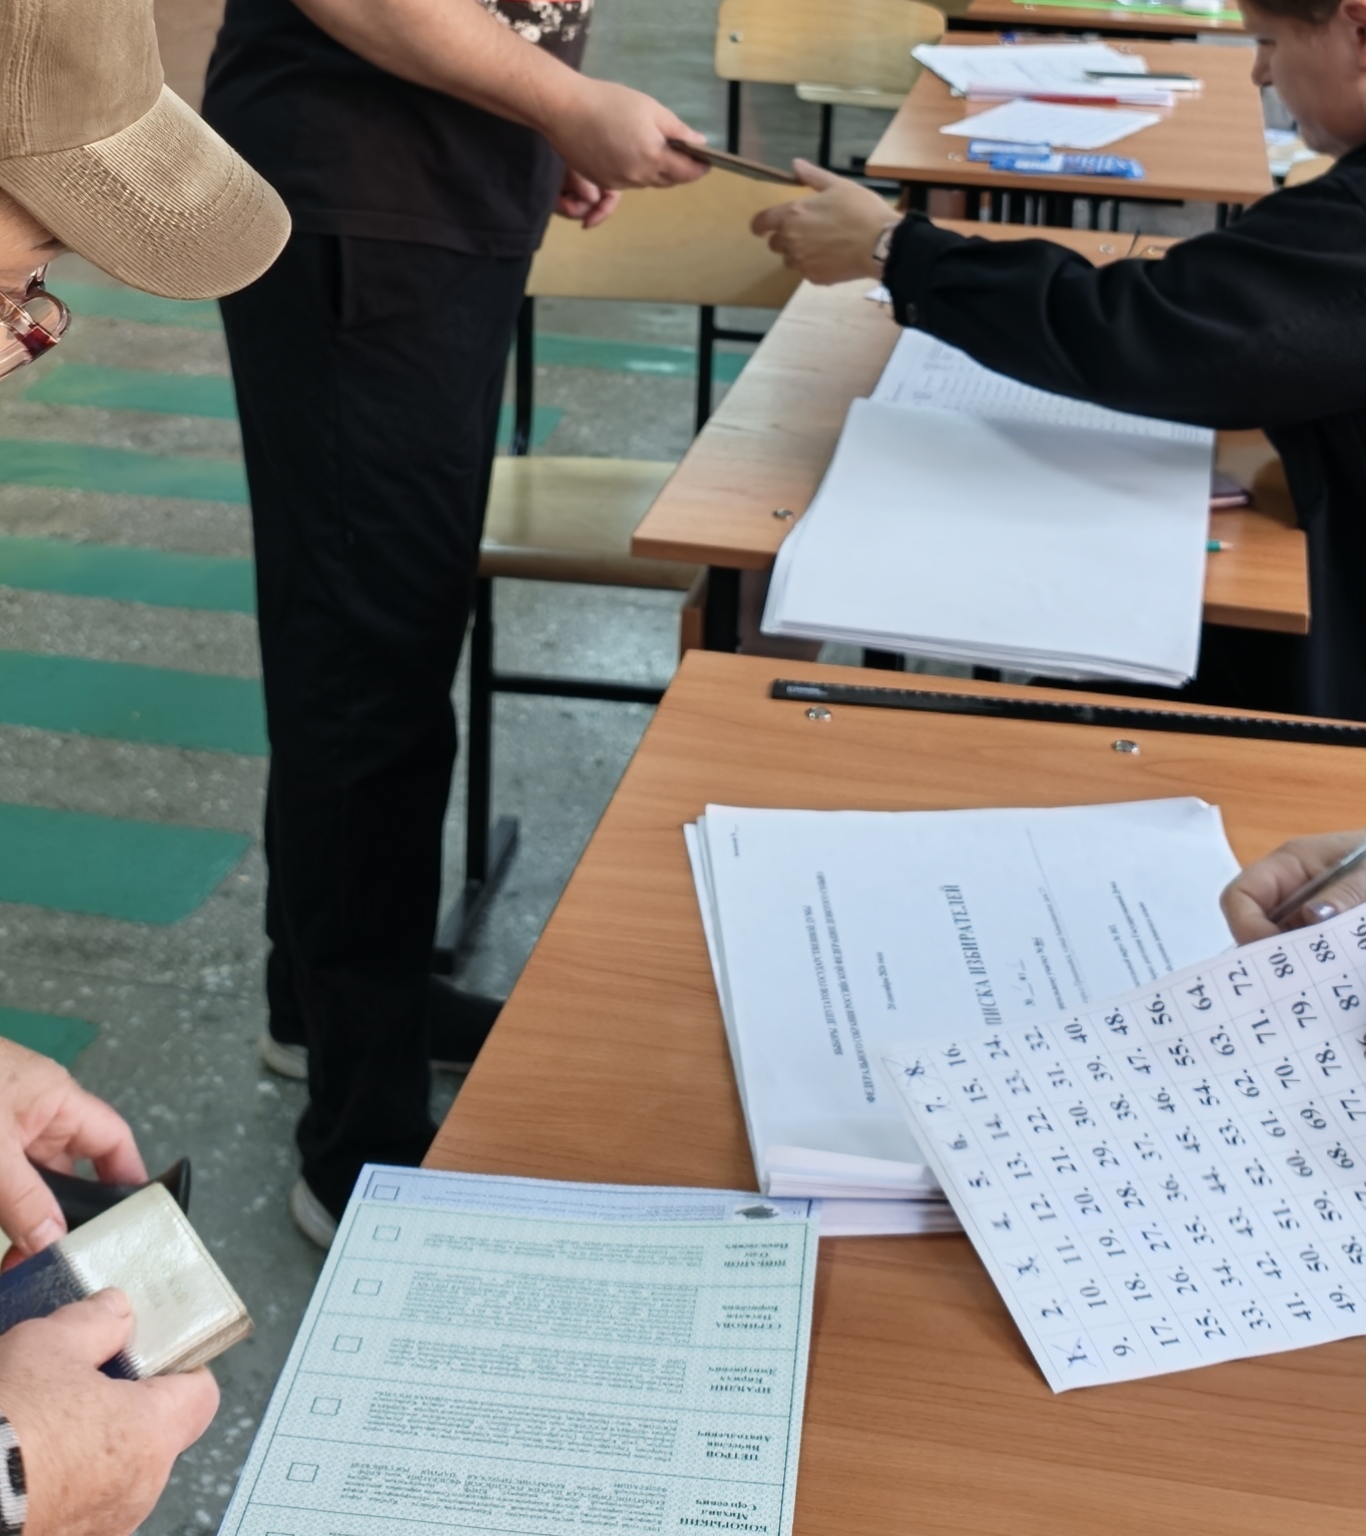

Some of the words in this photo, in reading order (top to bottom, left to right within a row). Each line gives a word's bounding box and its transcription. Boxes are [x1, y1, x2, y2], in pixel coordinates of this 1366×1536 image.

[943, 885, 987, 975] ИЗБИРАТЕЛЕЙ
[1268, 945, 1295, 979] 80.
[1307, 935, 1336, 964] 88.
[1227, 959, 1253, 997] 72.
[1331, 973, 1360, 1012] 87.
[975, 979, 1003, 1026] ПИСКА
[1186, 975, 1213, 1012] 64.
[1104, 1007, 1129, 1036] 48.
[1146, 992, 1173, 1026] 56.
[1291, 990, 1318, 1029] 79.
[1024, 1025, 1050, 1051] 32.
[1064, 1017, 1088, 1044] 40.
[1209, 1024, 1236, 1057] 63.
[1250, 1008, 1277, 1045] 71.
[944, 1043, 967, 1067] 16.
[984, 1034, 1010, 1060] 24.
[1126, 1047, 1152, 1075] 47.
[1167, 1037, 1196, 1067] 55.
[1314, 1041, 1342, 1077] 78.
[1005, 1069, 1031, 1095] 23.
[1046, 1062, 1073, 1088] 31.
[1086, 1055, 1114, 1082] 39.
[1233, 1068, 1260, 1098] 62.
[1274, 1056, 1301, 1090] 70.
[962, 1077, 988, 1103] 15.
[1155, 1086, 1176, 1114] 46.
[1192, 1078, 1221, 1107] 54.
[1027, 1106, 1054, 1134] 22.
[1068, 1100, 1096, 1127] 30.
[1109, 1093, 1138, 1121] 38.
[1299, 1100, 1327, 1130] 69.
[985, 1113, 1010, 1140] 14.
[1218, 1117, 1247, 1146] 53.
[1260, 1110, 1286, 1138] 61.
[1092, 1140, 1121, 1168] 29.
[1133, 1132, 1163, 1161] 37.
[1175, 1125, 1201, 1154] 45.
[1006, 1152, 1033, 1180] 13.
[1050, 1146, 1078, 1174] 21.
[1286, 1149, 1314, 1178] 60.
[1326, 1141, 1355, 1170] 68.
[967, 1170, 991, 1188] 5.
[1202, 1165, 1227, 1195] 44.
[1244, 1157, 1273, 1187] 52.
[1073, 1186, 1102, 1215] 20.
[1115, 1180, 1146, 1209] 28.
[1164, 1173, 1188, 1202] 36.
[1029, 1193, 1057, 1222] 12.
[1272, 1198, 1301, 1230] 51.
[1313, 1190, 1343, 1222] 59.
[992, 1212, 1011, 1230] 4.
[1184, 1215, 1215, 1244] 35.
[1228, 1207, 1254, 1238] 43.
[1056, 1235, 1082, 1265] 11.
[1098, 1228, 1127, 1257] 19.
[1141, 1222, 1172, 1252] 27.
[1212, 1258, 1243, 1287] 34.
[1256, 1250, 1282, 1280] 42.
[1299, 1243, 1329, 1273] 50.
[1079, 1278, 1108, 1309] 10.
[1124, 1272, 1153, 1302] 18.
[1172, 1265, 1199, 1295] 26.
[1285, 1292, 1312, 1322] 41.
[1328, 1284, 1356, 1314] 49.
[1194, 1308, 1227, 1339] 25.
[1241, 1299, 1272, 1330] 33.
[1149, 1316, 1180, 1347] 17.
[1112, 1336, 1134, 1357] 9.
[706, 1450, 759, 1461] ПЕТРОВ
[695, 1498, 758, 1512] Сергеевич
[701, 1508, 749, 1521] Михаил
[679, 1517, 768, 1534] БОБОРЫКИН
